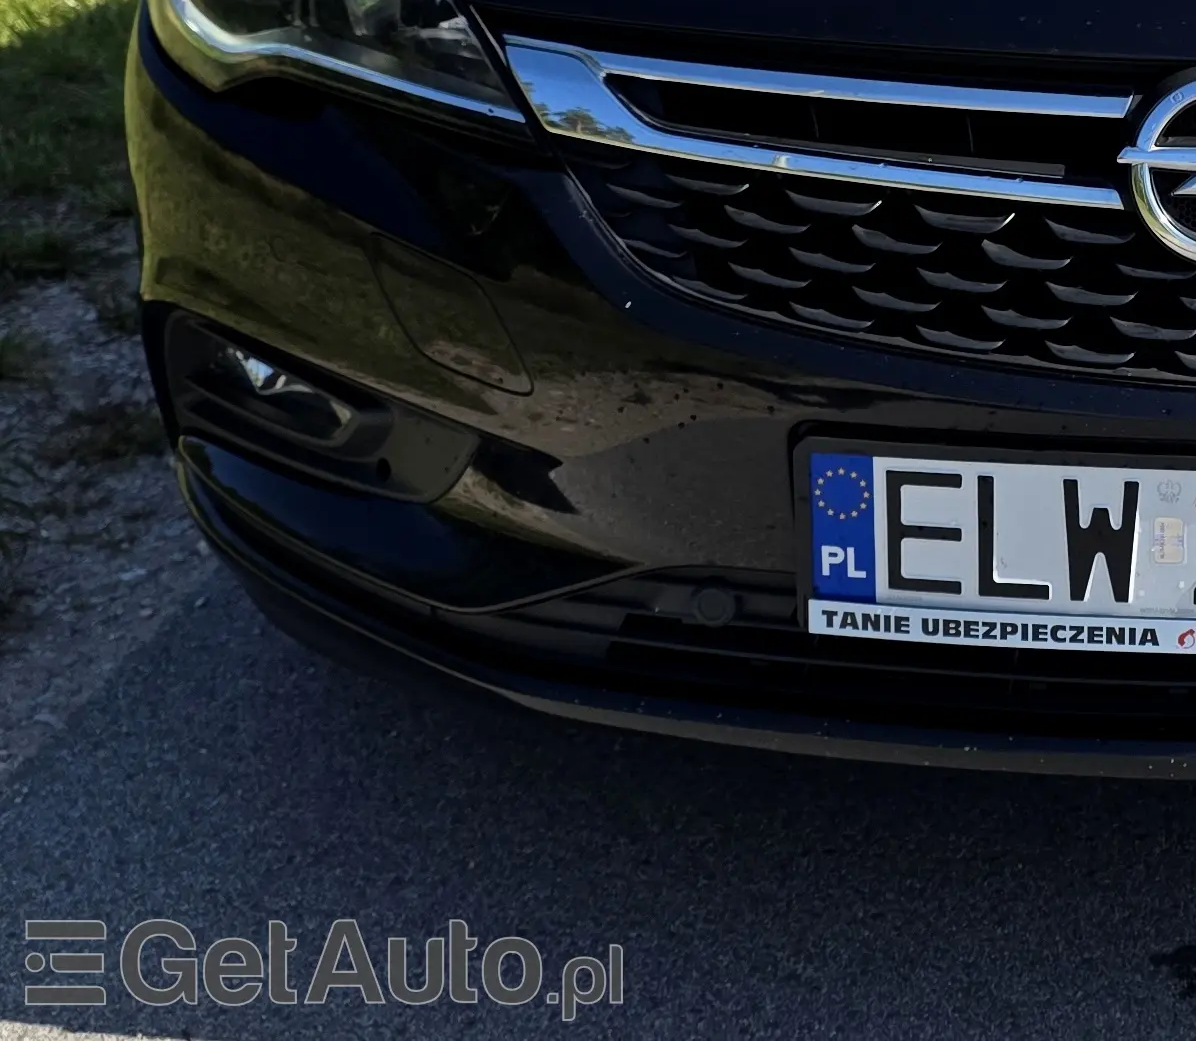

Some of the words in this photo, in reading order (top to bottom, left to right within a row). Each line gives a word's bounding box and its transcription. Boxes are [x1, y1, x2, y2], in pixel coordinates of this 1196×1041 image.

[886, 470, 1140, 603] ELW
[821, 542, 866, 578] PL
[821, 609, 911, 635] TANIE
[921, 617, 1160, 647] UBEZPIECZENIA
